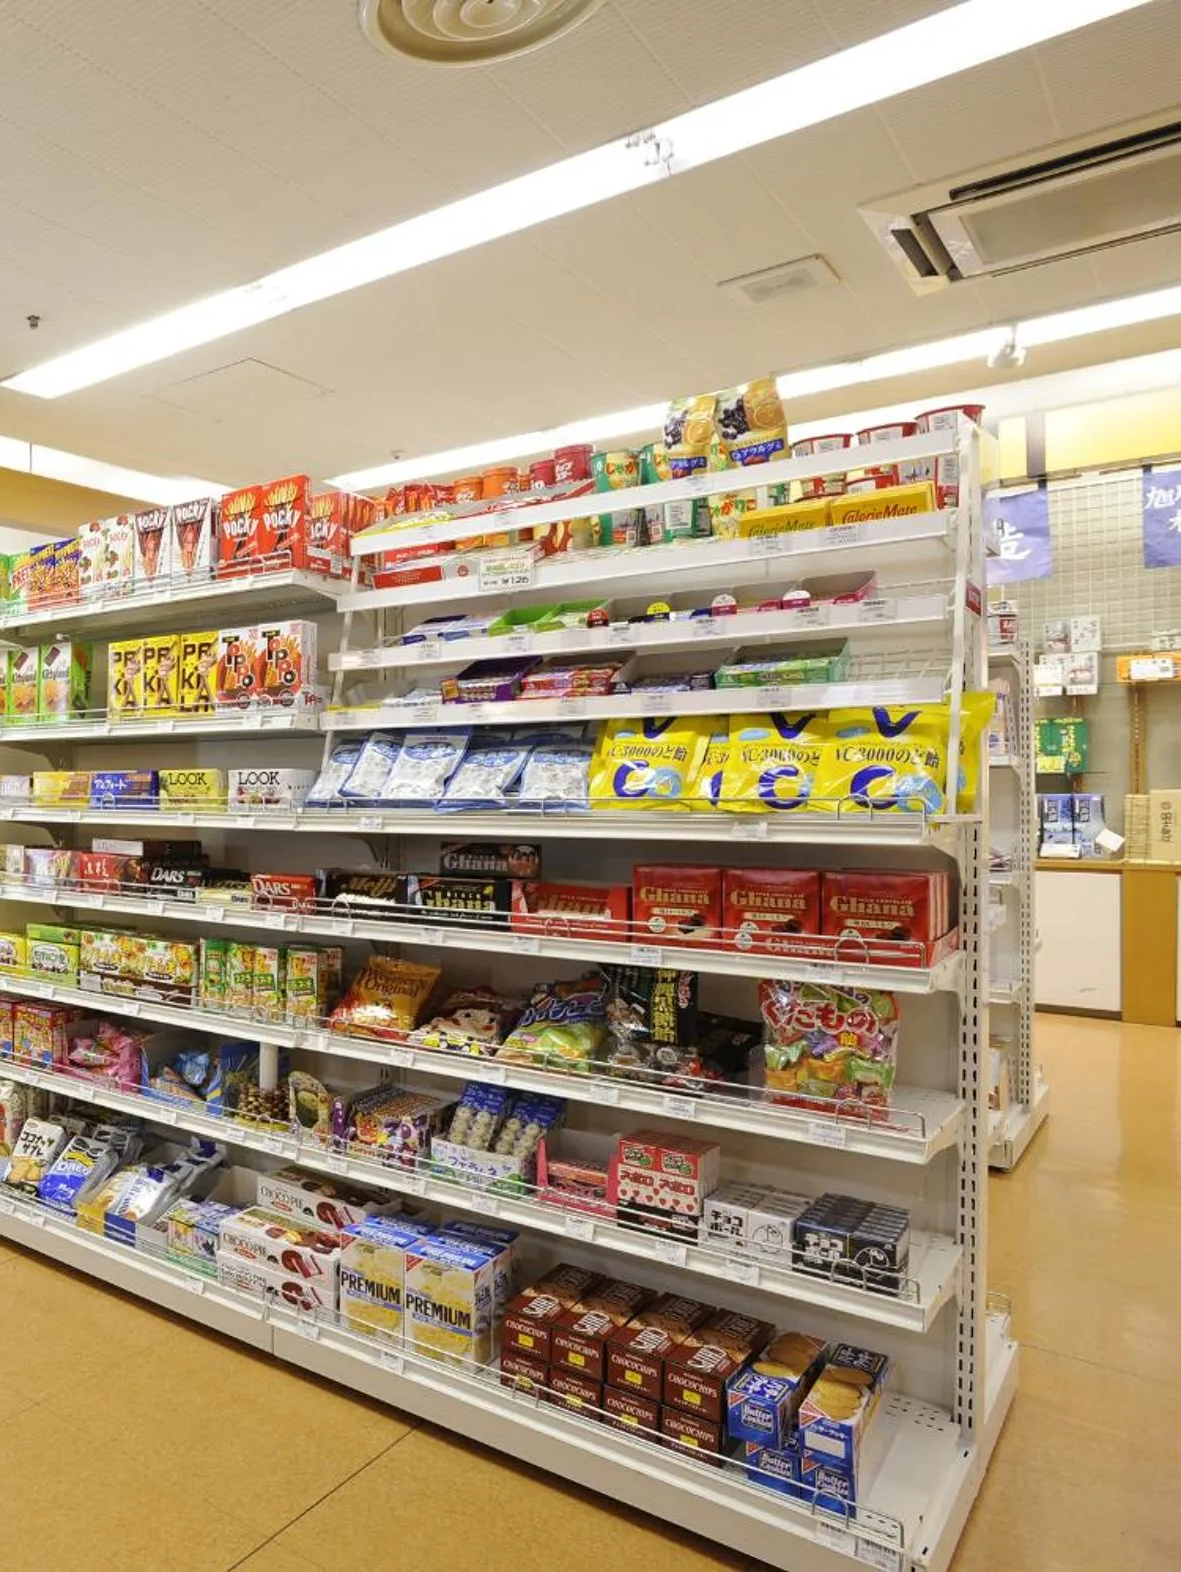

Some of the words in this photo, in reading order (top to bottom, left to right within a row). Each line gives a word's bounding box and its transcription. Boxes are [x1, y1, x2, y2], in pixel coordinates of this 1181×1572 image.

[137, 510, 168, 531] POCKY
[175, 501, 208, 522] POCKY
[262, 505, 301, 532] POCKY
[223, 514, 259, 540] POCKY
[169, 772, 207, 786] LOOK
[238, 771, 281, 786] LOOK
[444, 851, 509, 872] Ghana
[151, 867, 185, 883] DARS
[252, 878, 291, 896] DARS
[639, 886, 710, 905] Ghana
[415, 889, 496, 912] Ghana
[730, 889, 806, 910] Ghana
[829, 895, 916, 917] Ghana
[20, 1131, 57, 1147] ココナッツ
[710, 1209, 744, 1228] チョコ
[341, 1271, 401, 1305] PREMIUM
[405, 1292, 471, 1330] PREMIUM
[506, 1319, 548, 1340] CHOCOCHIPS
[555, 1336, 599, 1359] CHOCOCHIPS
[611, 1354, 658, 1378] CHOCOCHIPS
[669, 1372, 718, 1398] CHOCOCHIPS
[744, 1404, 773, 1420] Butter
[665, 1417, 715, 1443] CHOCOCHIPS
[762, 1452, 792, 1469] Butter
[819, 1471, 849, 1488] Butter
